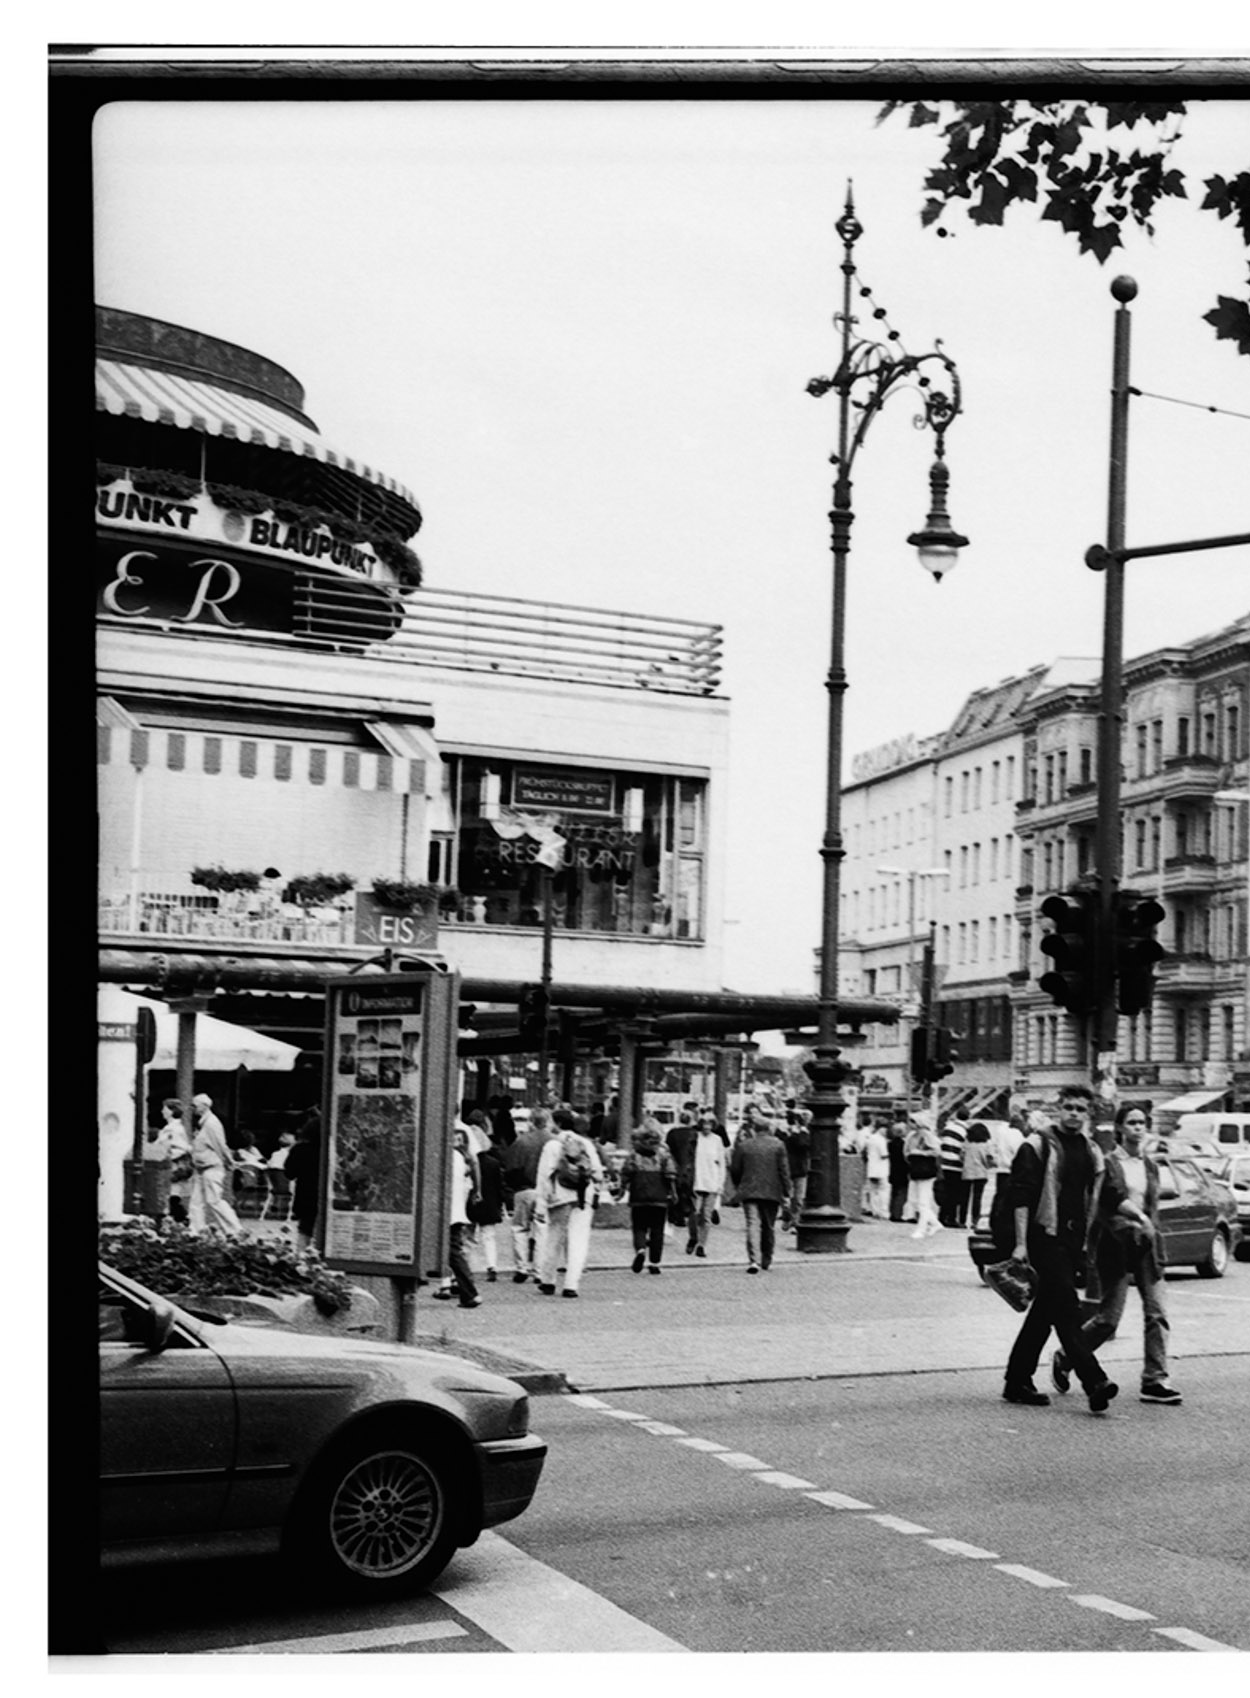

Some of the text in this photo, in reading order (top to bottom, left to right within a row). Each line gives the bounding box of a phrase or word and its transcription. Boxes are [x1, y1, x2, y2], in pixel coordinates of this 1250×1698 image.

[250, 517, 377, 578] BLAUPUNKT
[500, 841, 635, 870] RESURANT
[380, 915, 415, 944] EIS
